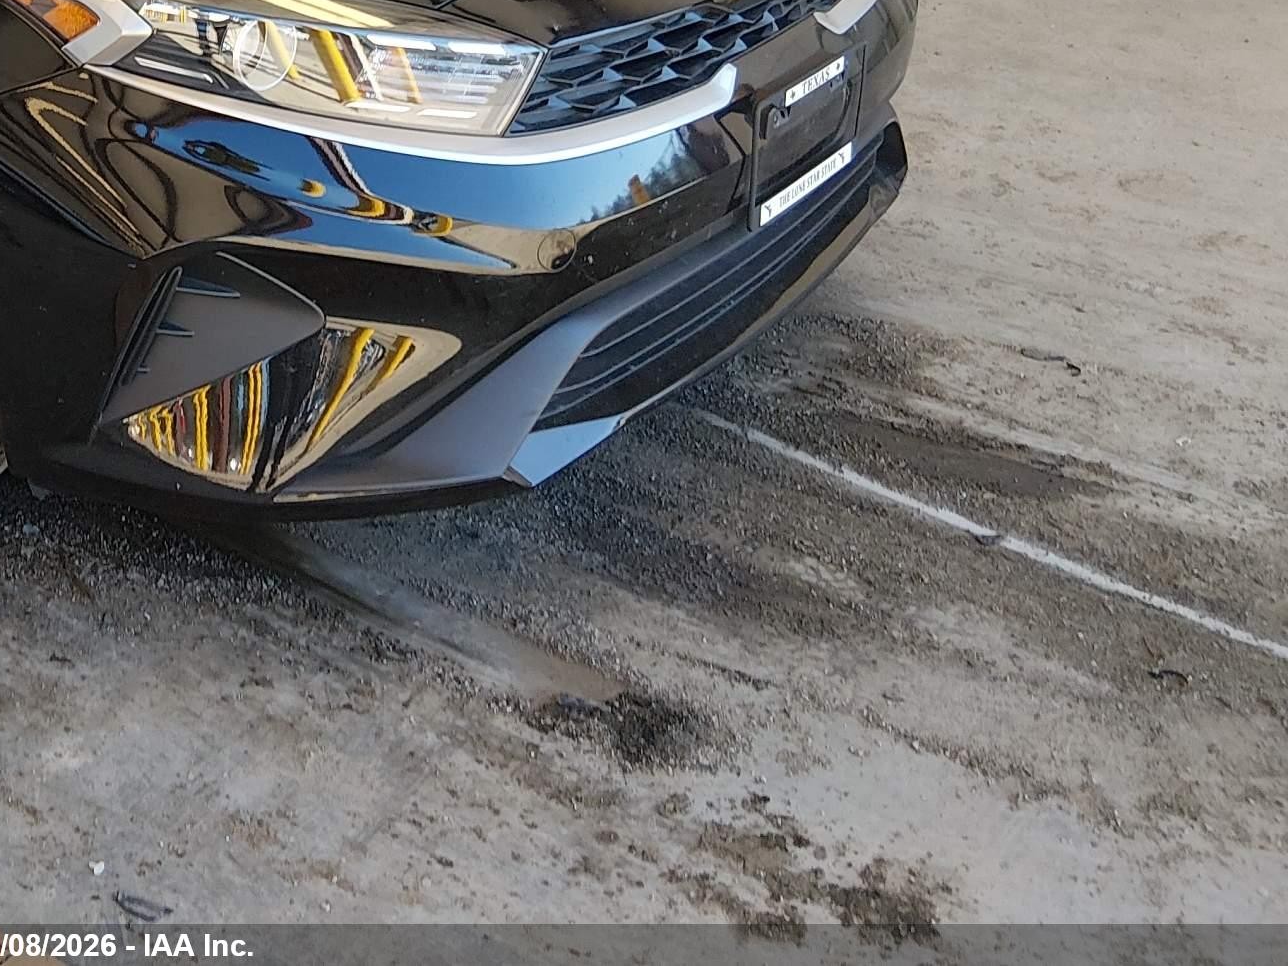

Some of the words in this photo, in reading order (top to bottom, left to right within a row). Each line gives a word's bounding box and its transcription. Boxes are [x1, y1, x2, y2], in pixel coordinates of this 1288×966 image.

[801, 68, 831, 94] TEXAS
[779, 192, 791, 209] THE
[791, 181, 806, 200] LONE
[807, 170, 821, 188] STAR
[820, 159, 836, 178] STATE
